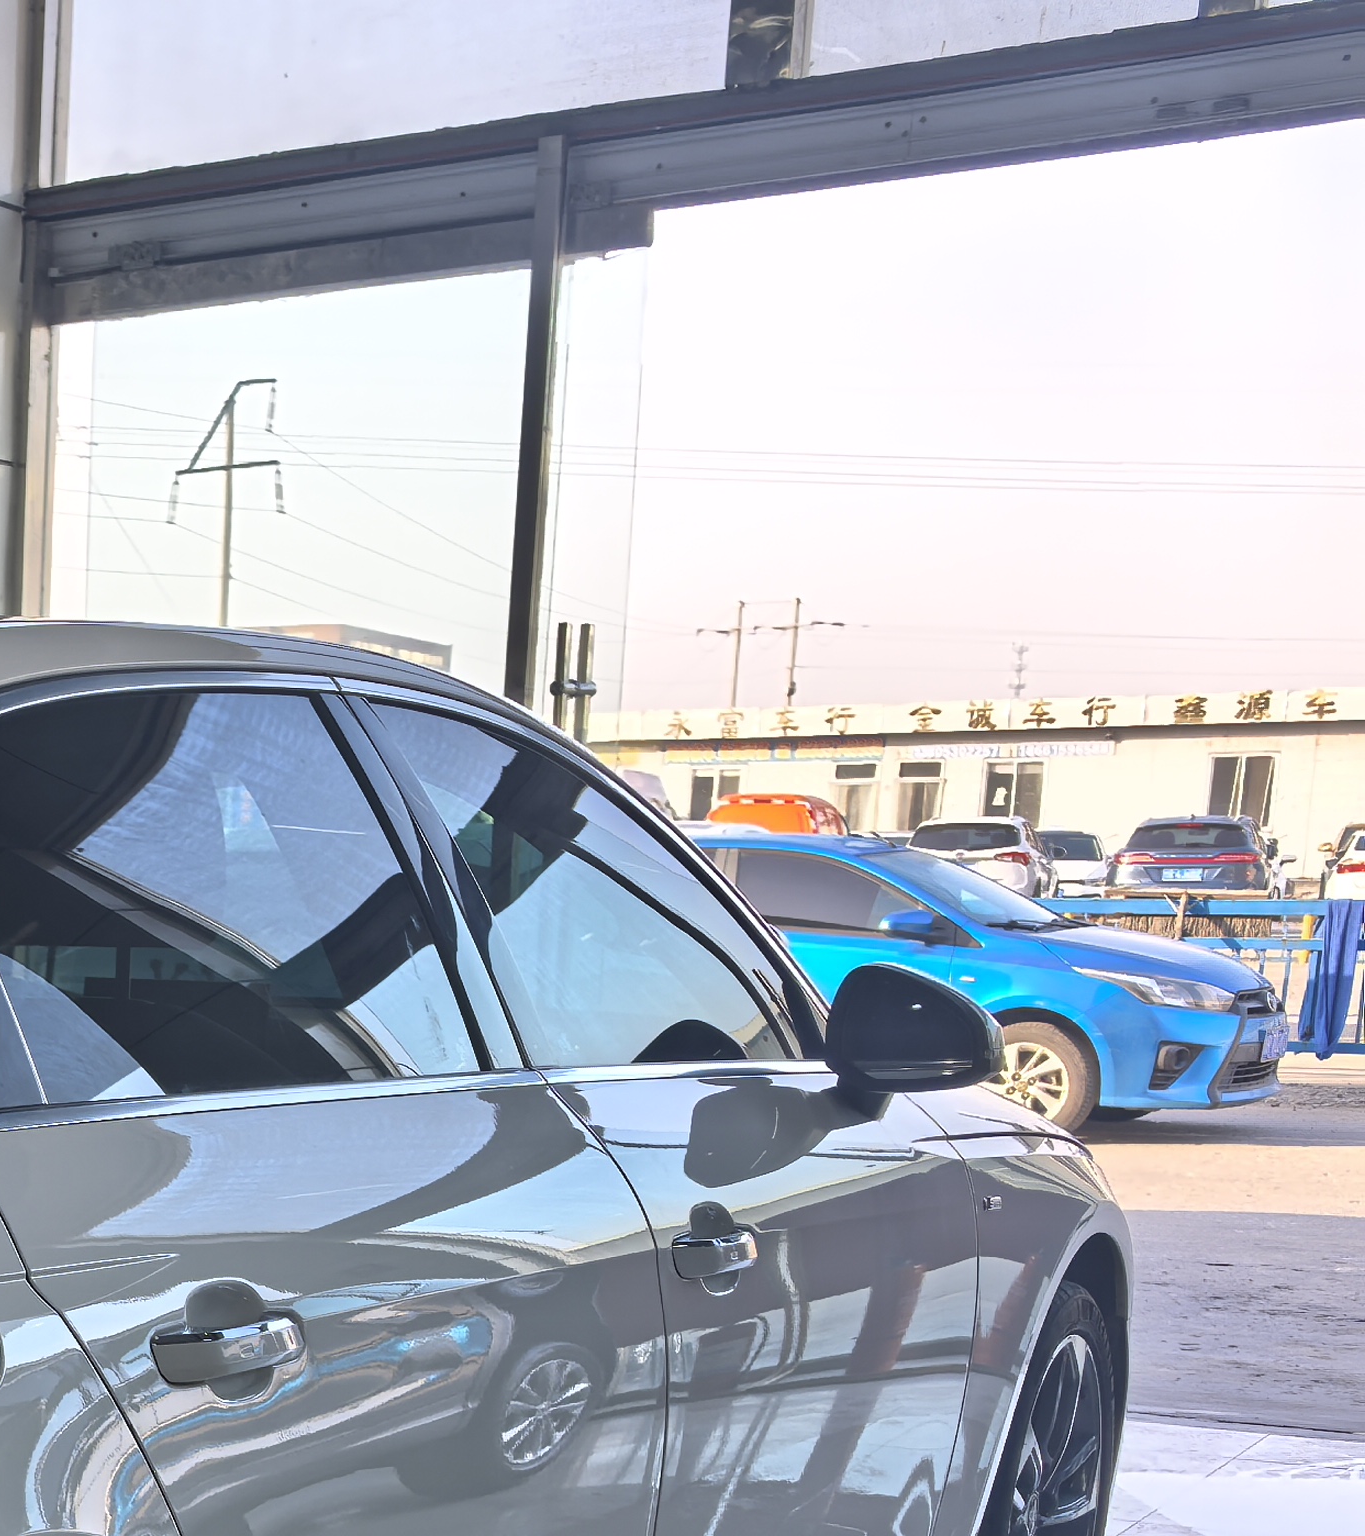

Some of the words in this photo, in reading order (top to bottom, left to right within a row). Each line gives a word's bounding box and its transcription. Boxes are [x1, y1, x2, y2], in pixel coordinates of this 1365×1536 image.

[664, 706, 857, 740] 永富车行
[1173, 689, 1338, 723] 鑫源车
